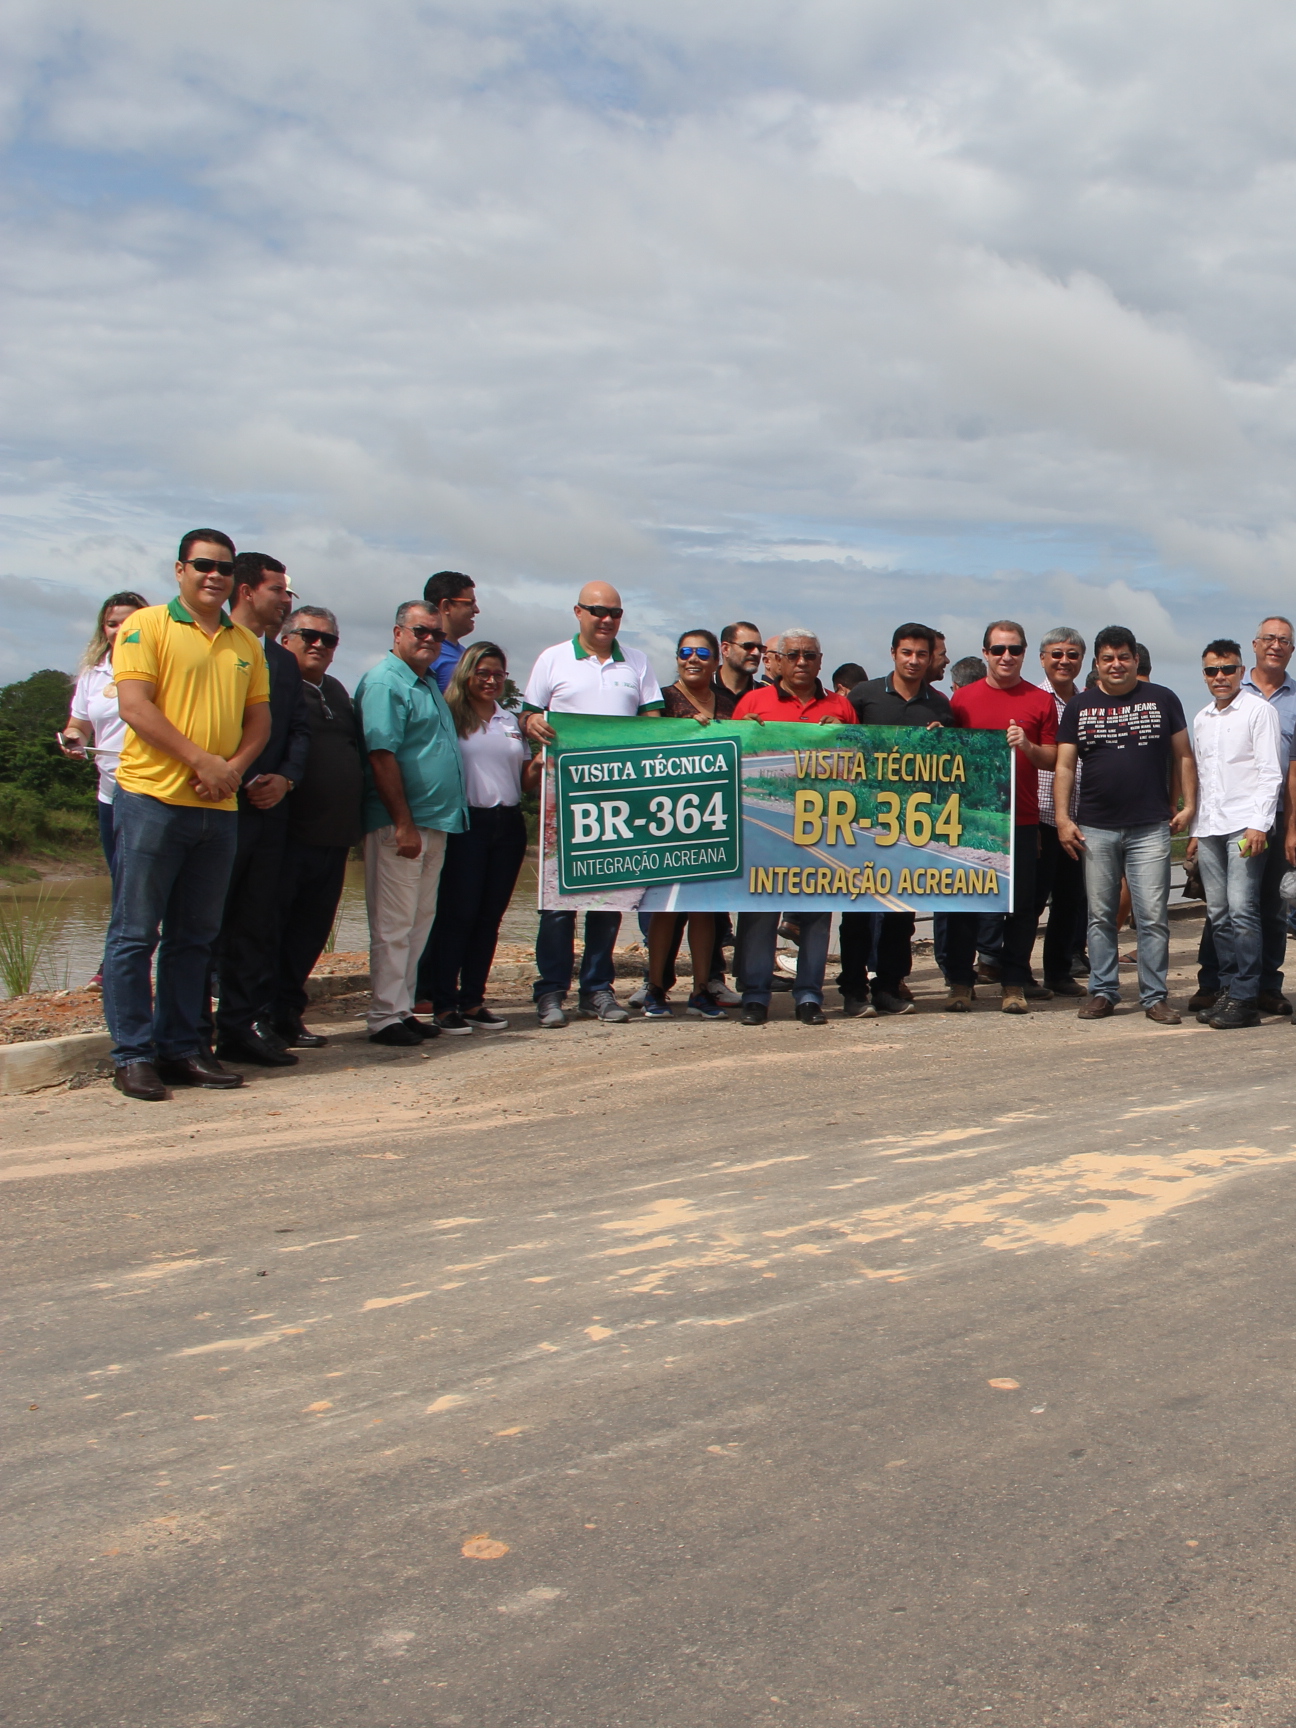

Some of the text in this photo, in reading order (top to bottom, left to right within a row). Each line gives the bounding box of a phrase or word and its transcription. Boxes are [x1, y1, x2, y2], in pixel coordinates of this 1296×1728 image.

[1133, 702, 1157, 712] JEANS
[568, 753, 729, 785] VISITA TÉCNICA
[794, 746, 966, 783] VISITA TÉCNICA
[570, 790, 729, 844] BR-364
[793, 789, 963, 847] BR-364
[572, 847, 727, 877] INTEGRAÇÃO ACREANA
[749, 861, 999, 900] INTEGRAÇÃO ACREANA
